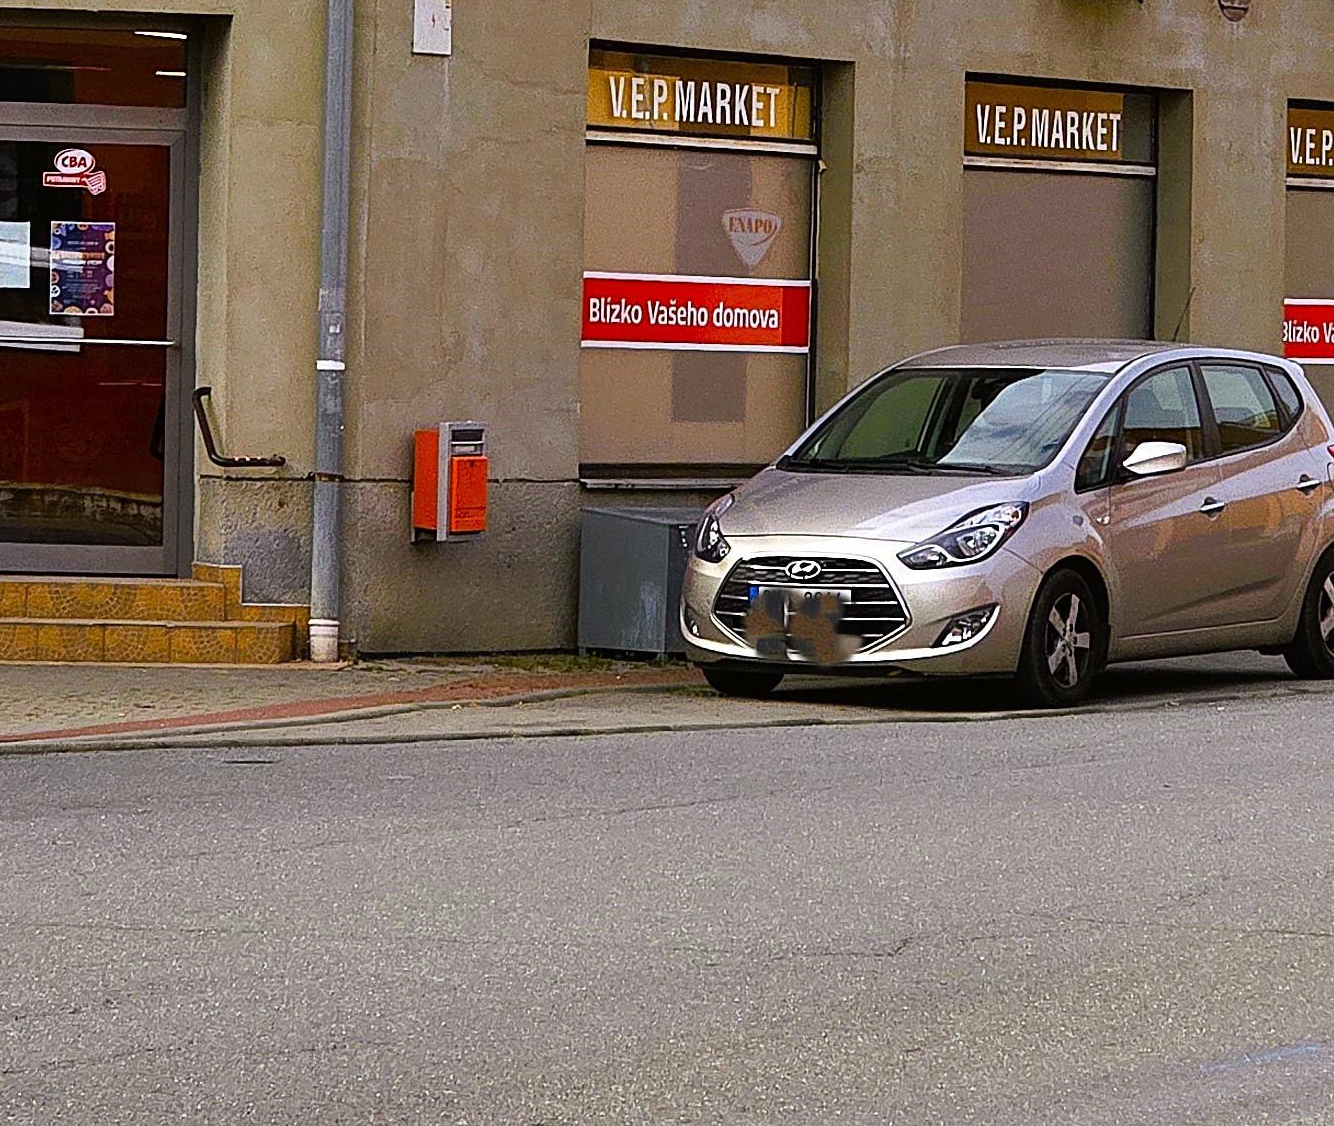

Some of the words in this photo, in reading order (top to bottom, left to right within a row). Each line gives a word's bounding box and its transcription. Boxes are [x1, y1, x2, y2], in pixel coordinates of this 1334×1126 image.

[609, 76, 668, 121] V.E.P.
[675, 80, 780, 127] MARKET
[976, 104, 1026, 146] V.E.P.
[1031, 108, 1121, 151] MARKET
[1290, 127, 1333, 166] V.E.P.
[61, 155, 87, 168] CBA
[589, 297, 642, 324] Blízko
[647, 298, 708, 327] Vašeho
[713, 301, 779, 328] domova
